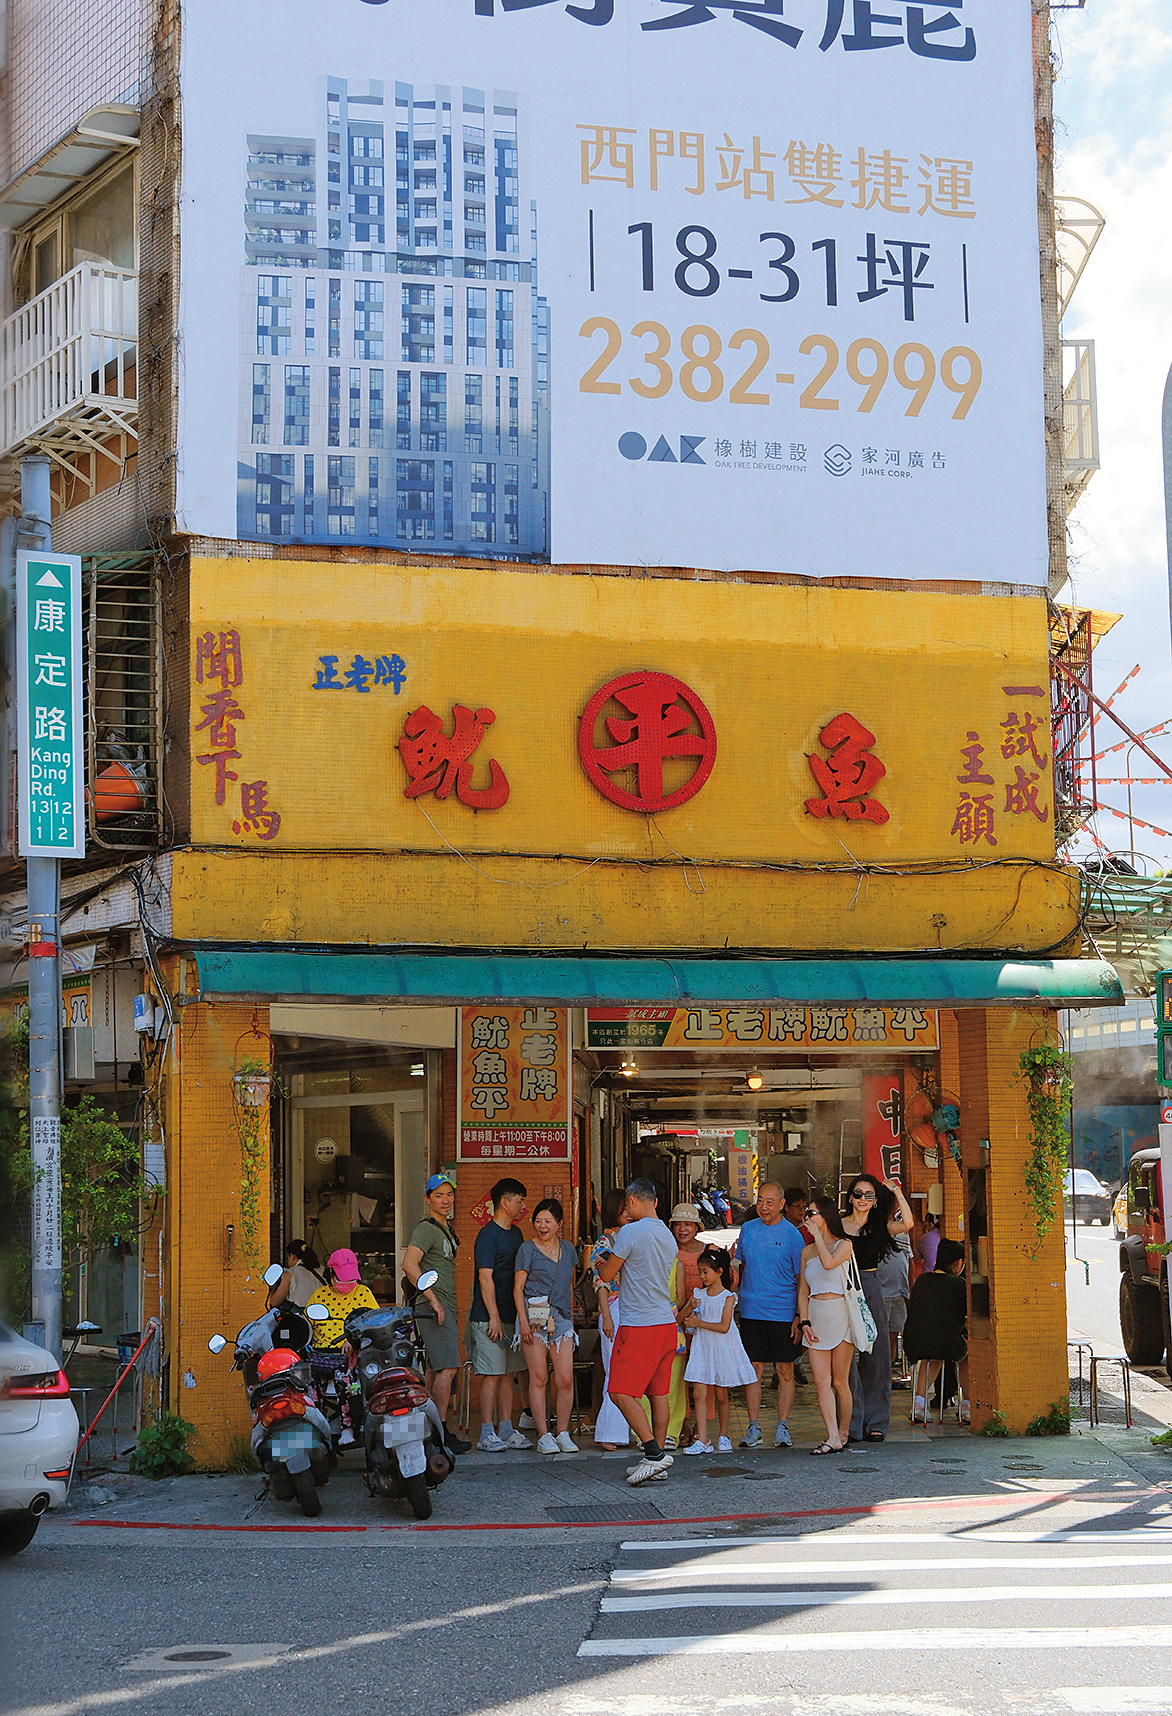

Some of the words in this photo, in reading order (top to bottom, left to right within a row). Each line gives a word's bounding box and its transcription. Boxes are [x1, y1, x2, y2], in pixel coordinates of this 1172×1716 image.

[576, 124, 977, 219] 西門站雙捷運
[628, 222, 935, 322] 18-31坪
[578, 316, 983, 420] 2382-2999
[714, 438, 808, 462] 橡樹建設
[861, 446, 947, 469] 家河廣告
[714, 460, 731, 468] OAK
[734, 462, 751, 470] TREE
[753, 463, 807, 472] DEVELOPMENT
[861, 467, 885, 476] JIAHE
[888, 470, 913, 478] CORP.
[34, 598, 67, 742] 康定路
[312, 653, 407, 695] 正老牌
[195, 629, 281, 840] 聞香下馬
[31, 747, 71, 767] Kang
[31, 764, 67, 784] Ding
[31, 782, 57, 797] Rd.
[684, 1007, 928, 1041] 正老牌魷魚平
[471, 1016, 510, 1119] 魷魚平
[480, 1145, 551, 1156] 每星期二公休
